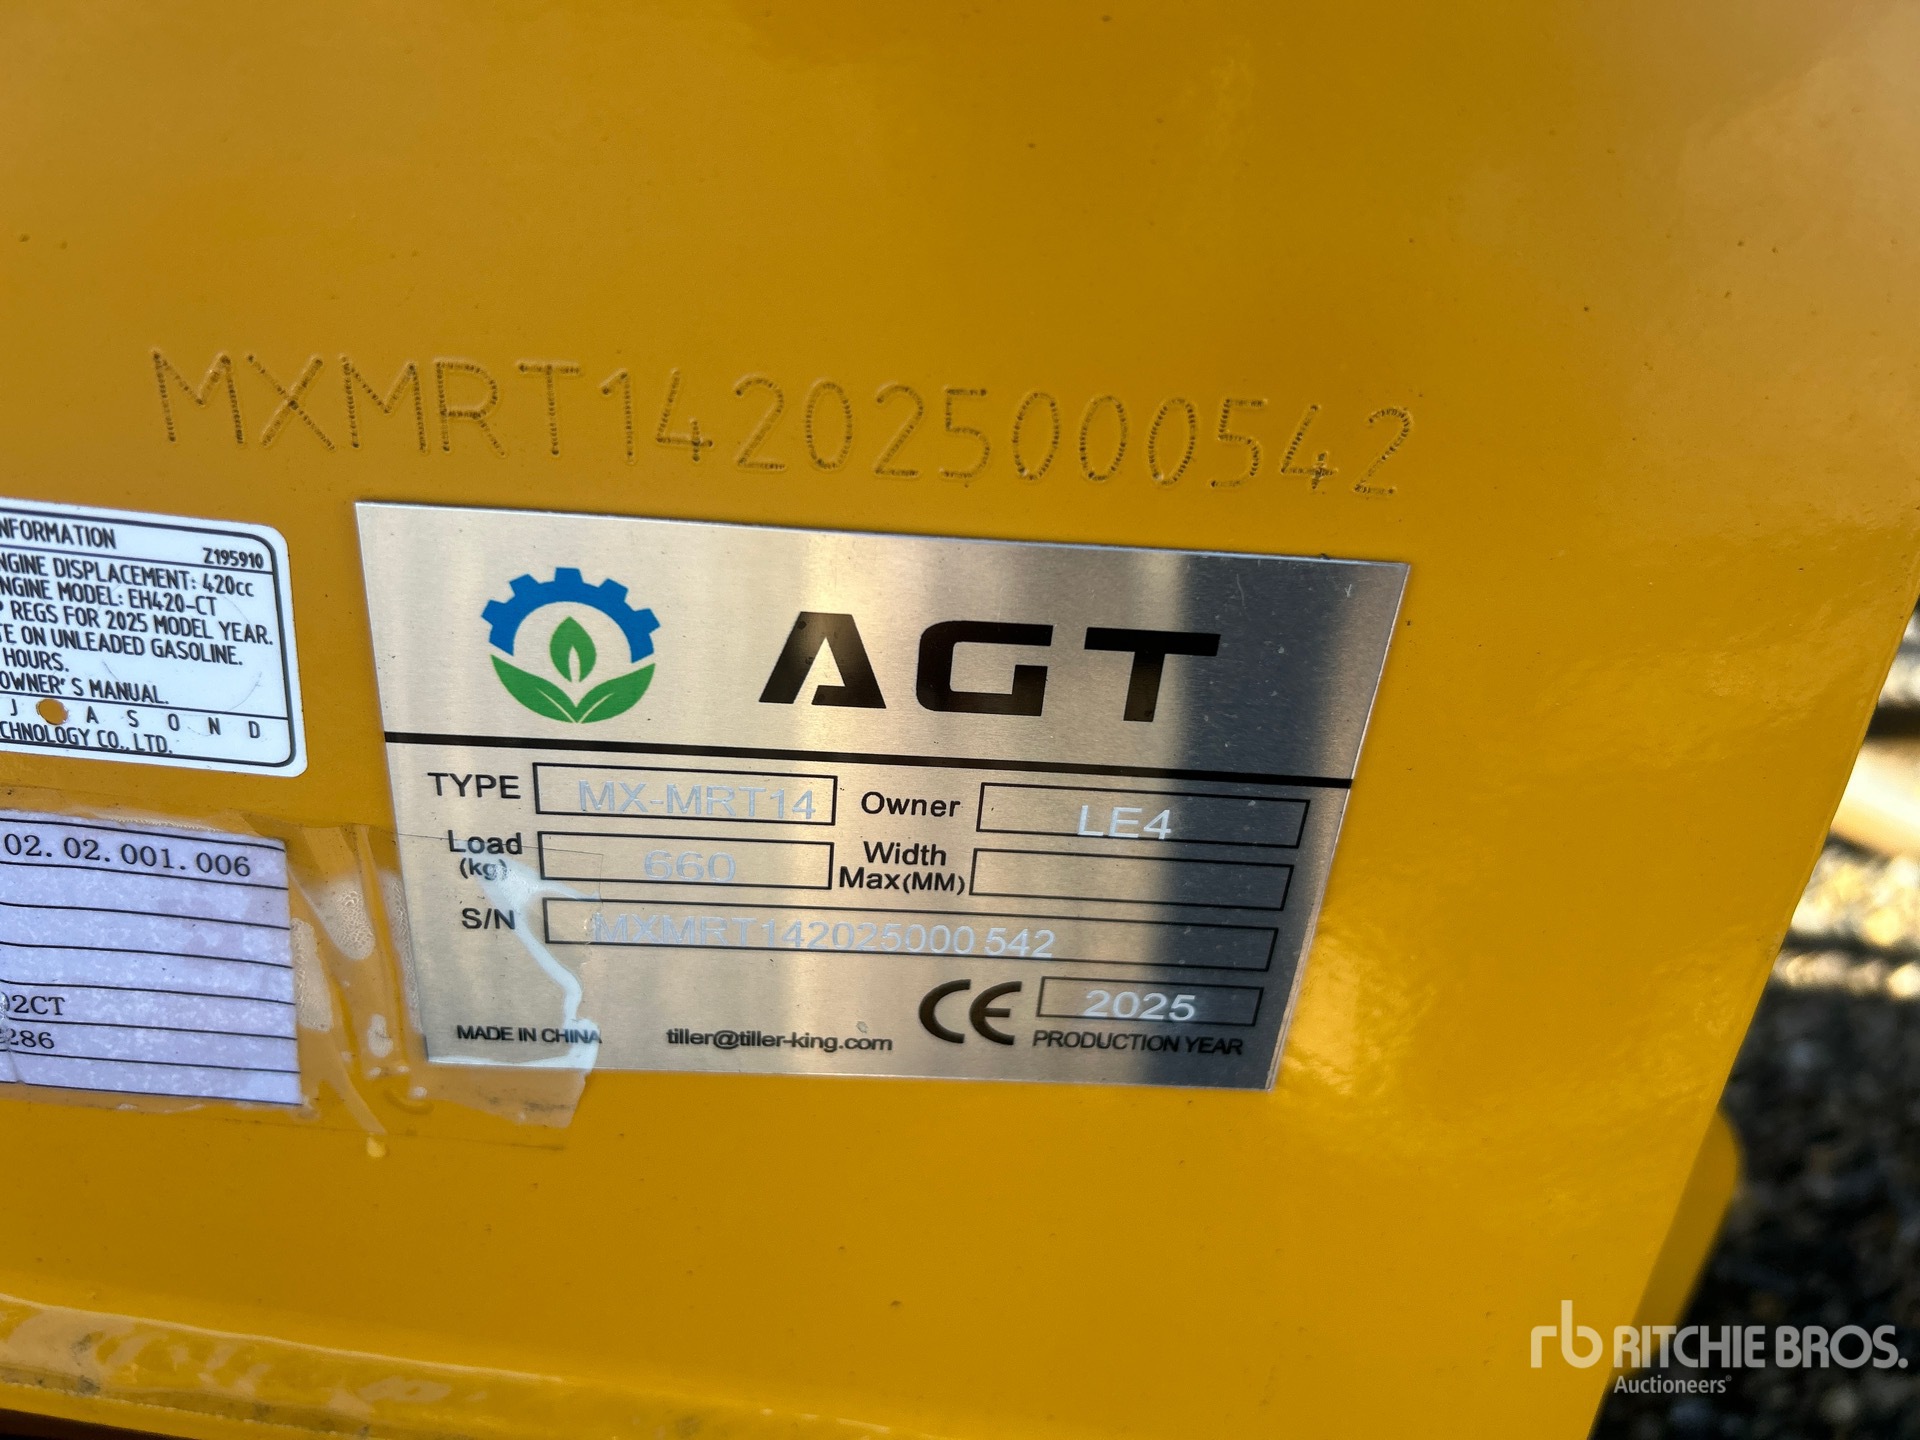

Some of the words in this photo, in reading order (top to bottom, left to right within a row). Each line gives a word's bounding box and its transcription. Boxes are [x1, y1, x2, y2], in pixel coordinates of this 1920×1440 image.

[151, 349, 1414, 496] MXMRT142025000542
[203, 547, 264, 569] Z195910
[53, 557, 197, 590] DISPLACEMENT:
[203, 573, 254, 597] 420cc
[57, 581, 123, 606] MODEL:
[128, 588, 216, 616] EH420-CT
[11, 600, 59, 625] REGS
[64, 606, 100, 628] FOR
[106, 610, 148, 633] 2025
[153, 615, 214, 640] MODEL
[219, 621, 273, 645] YEAR.
[0, 623, 17, 644] E
[21, 626, 47, 646] ON
[51, 628, 145, 656] UNLEADED
[151, 638, 243, 666] GASOLINE.
[3, 647, 69, 672] HOURS.
[759, 611, 1220, 722] AGT
[89, 678, 169, 704] MANUAL.
[10, 698, 18, 716] J
[86, 705, 99, 724] A
[127, 710, 139, 727] S
[168, 713, 180, 731] O
[208, 717, 221, 735] N
[249, 721, 260, 739] D
[134, 733, 172, 754] LTD.
[428, 772, 520, 799] TYPE
[578, 780, 816, 820] MX-MRT14
[861, 791, 961, 818] Owner
[1077, 805, 1171, 840] LE4
[448, 830, 522, 855] Load
[863, 841, 947, 866] Width
[460, 857, 508, 881] (kg)
[644, 850, 736, 883] 660
[839, 867, 966, 896] Max(MM)
[461, 907, 516, 930] S/N
[919, 979, 1022, 1045] CE
[1084, 990, 1196, 1022] 2025
[456, 1025, 514, 1041] MADE
[518, 1027, 537, 1042] IN
[541, 1028, 603, 1044] CHINA
[666, 1028, 893, 1053] tiller@tiller-king.com
[1033, 1029, 1176, 1053] PRODUCTION
[1182, 1036, 1244, 1055] YEAR
